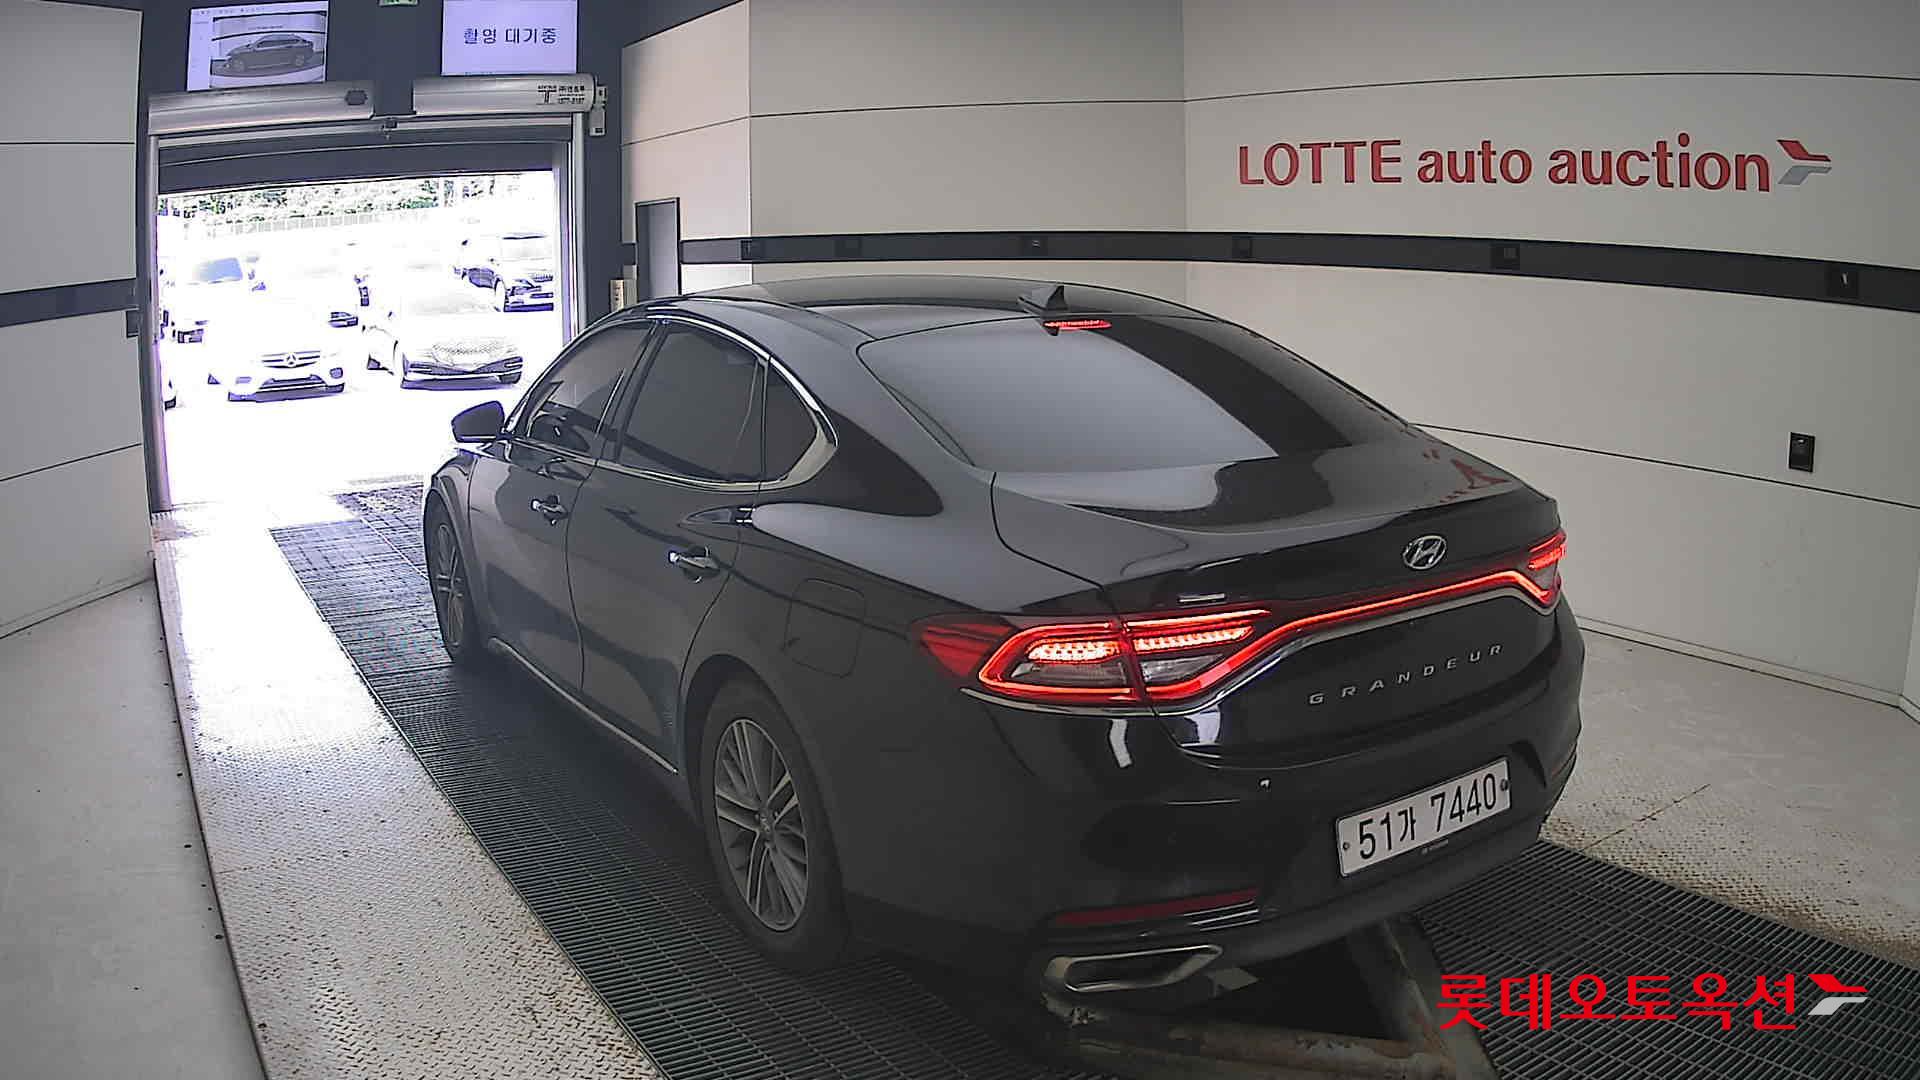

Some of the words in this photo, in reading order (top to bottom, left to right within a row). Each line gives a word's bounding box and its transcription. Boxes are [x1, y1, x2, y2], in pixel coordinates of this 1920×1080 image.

[505, 28, 557, 44] 대기중
[1239, 139, 1402, 187] LOTTE
[1417, 140, 1533, 185] auto
[1549, 132, 1771, 193] auction
[1308, 644, 1502, 705] GRANDEUR
[1358, 806, 1417, 860] 51가
[1430, 773, 1498, 833] 7440
